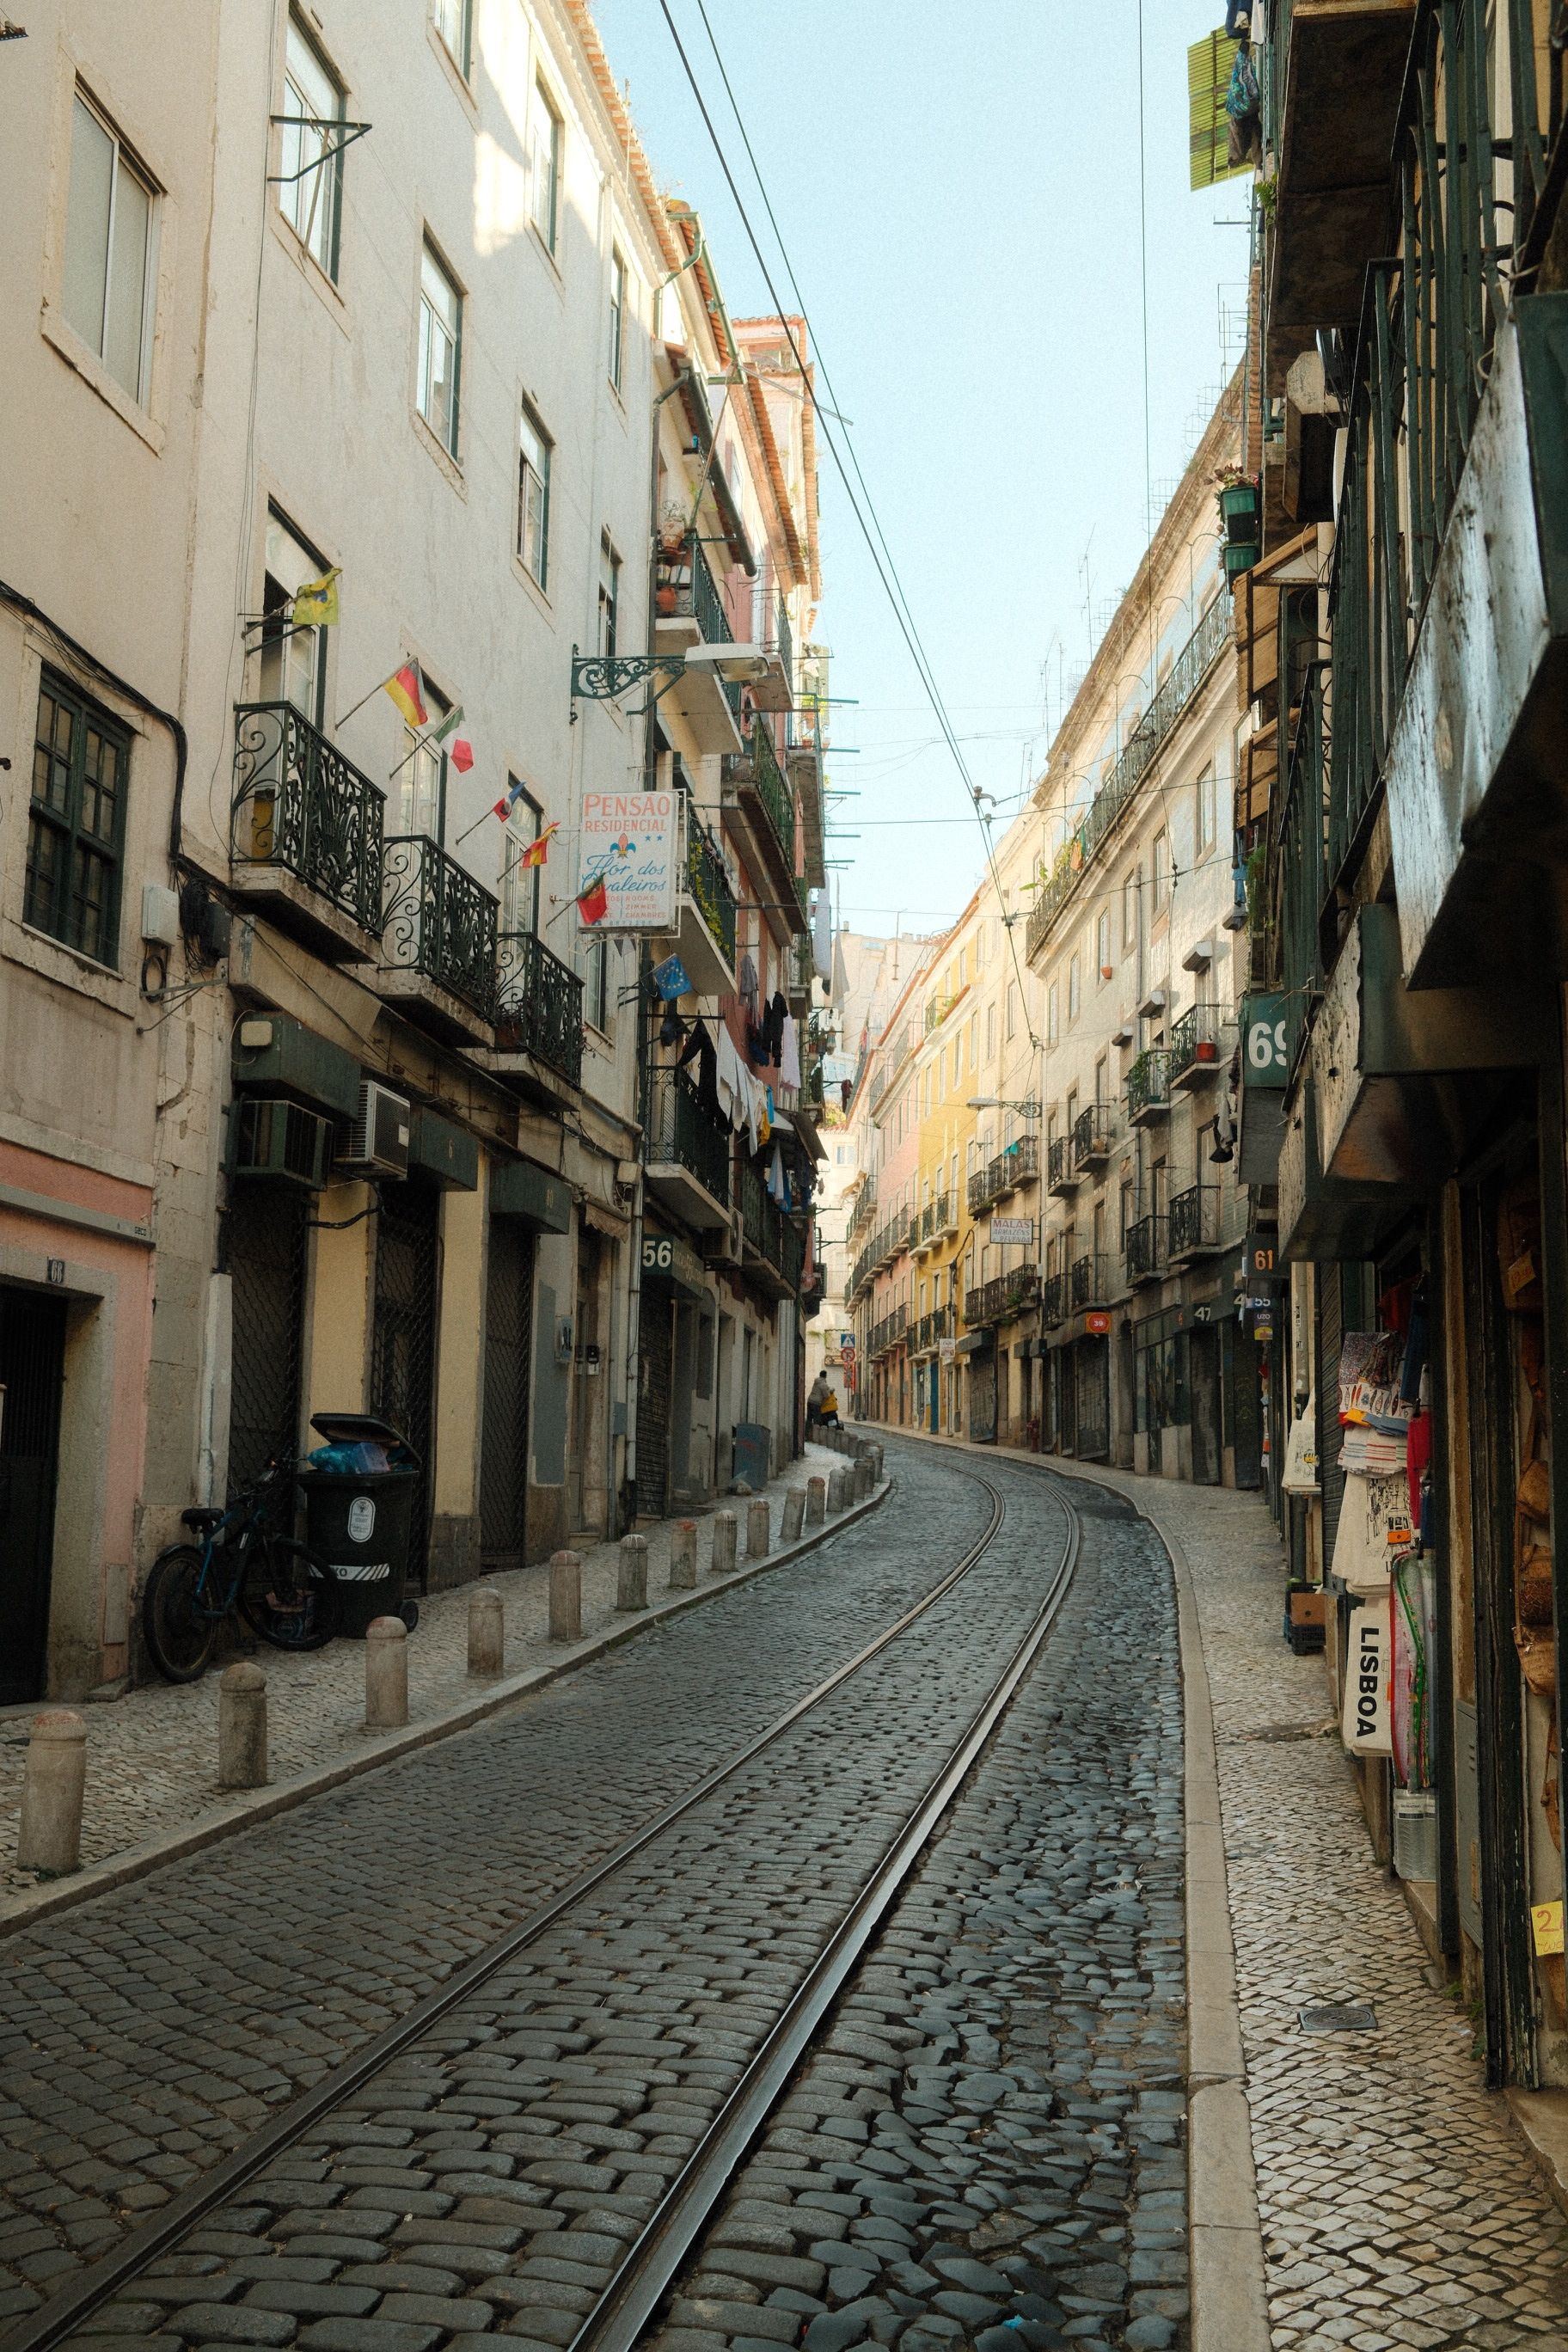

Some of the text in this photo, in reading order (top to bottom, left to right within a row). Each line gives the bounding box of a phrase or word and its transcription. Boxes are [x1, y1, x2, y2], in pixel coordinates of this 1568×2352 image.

[584, 793, 671, 817] PENSÃO
[585, 819, 667, 832] RESIDENCIAL
[637, 860, 666, 875] dos
[993, 1220, 1032, 1229] MALAS
[642, 1240, 671, 1268] 56
[1254, 1249, 1273, 1271] 61
[1254, 1297, 1271, 1307] 55
[1194, 1307, 1211, 1321] 47
[1357, 1626, 1380, 1737] LISBOA
